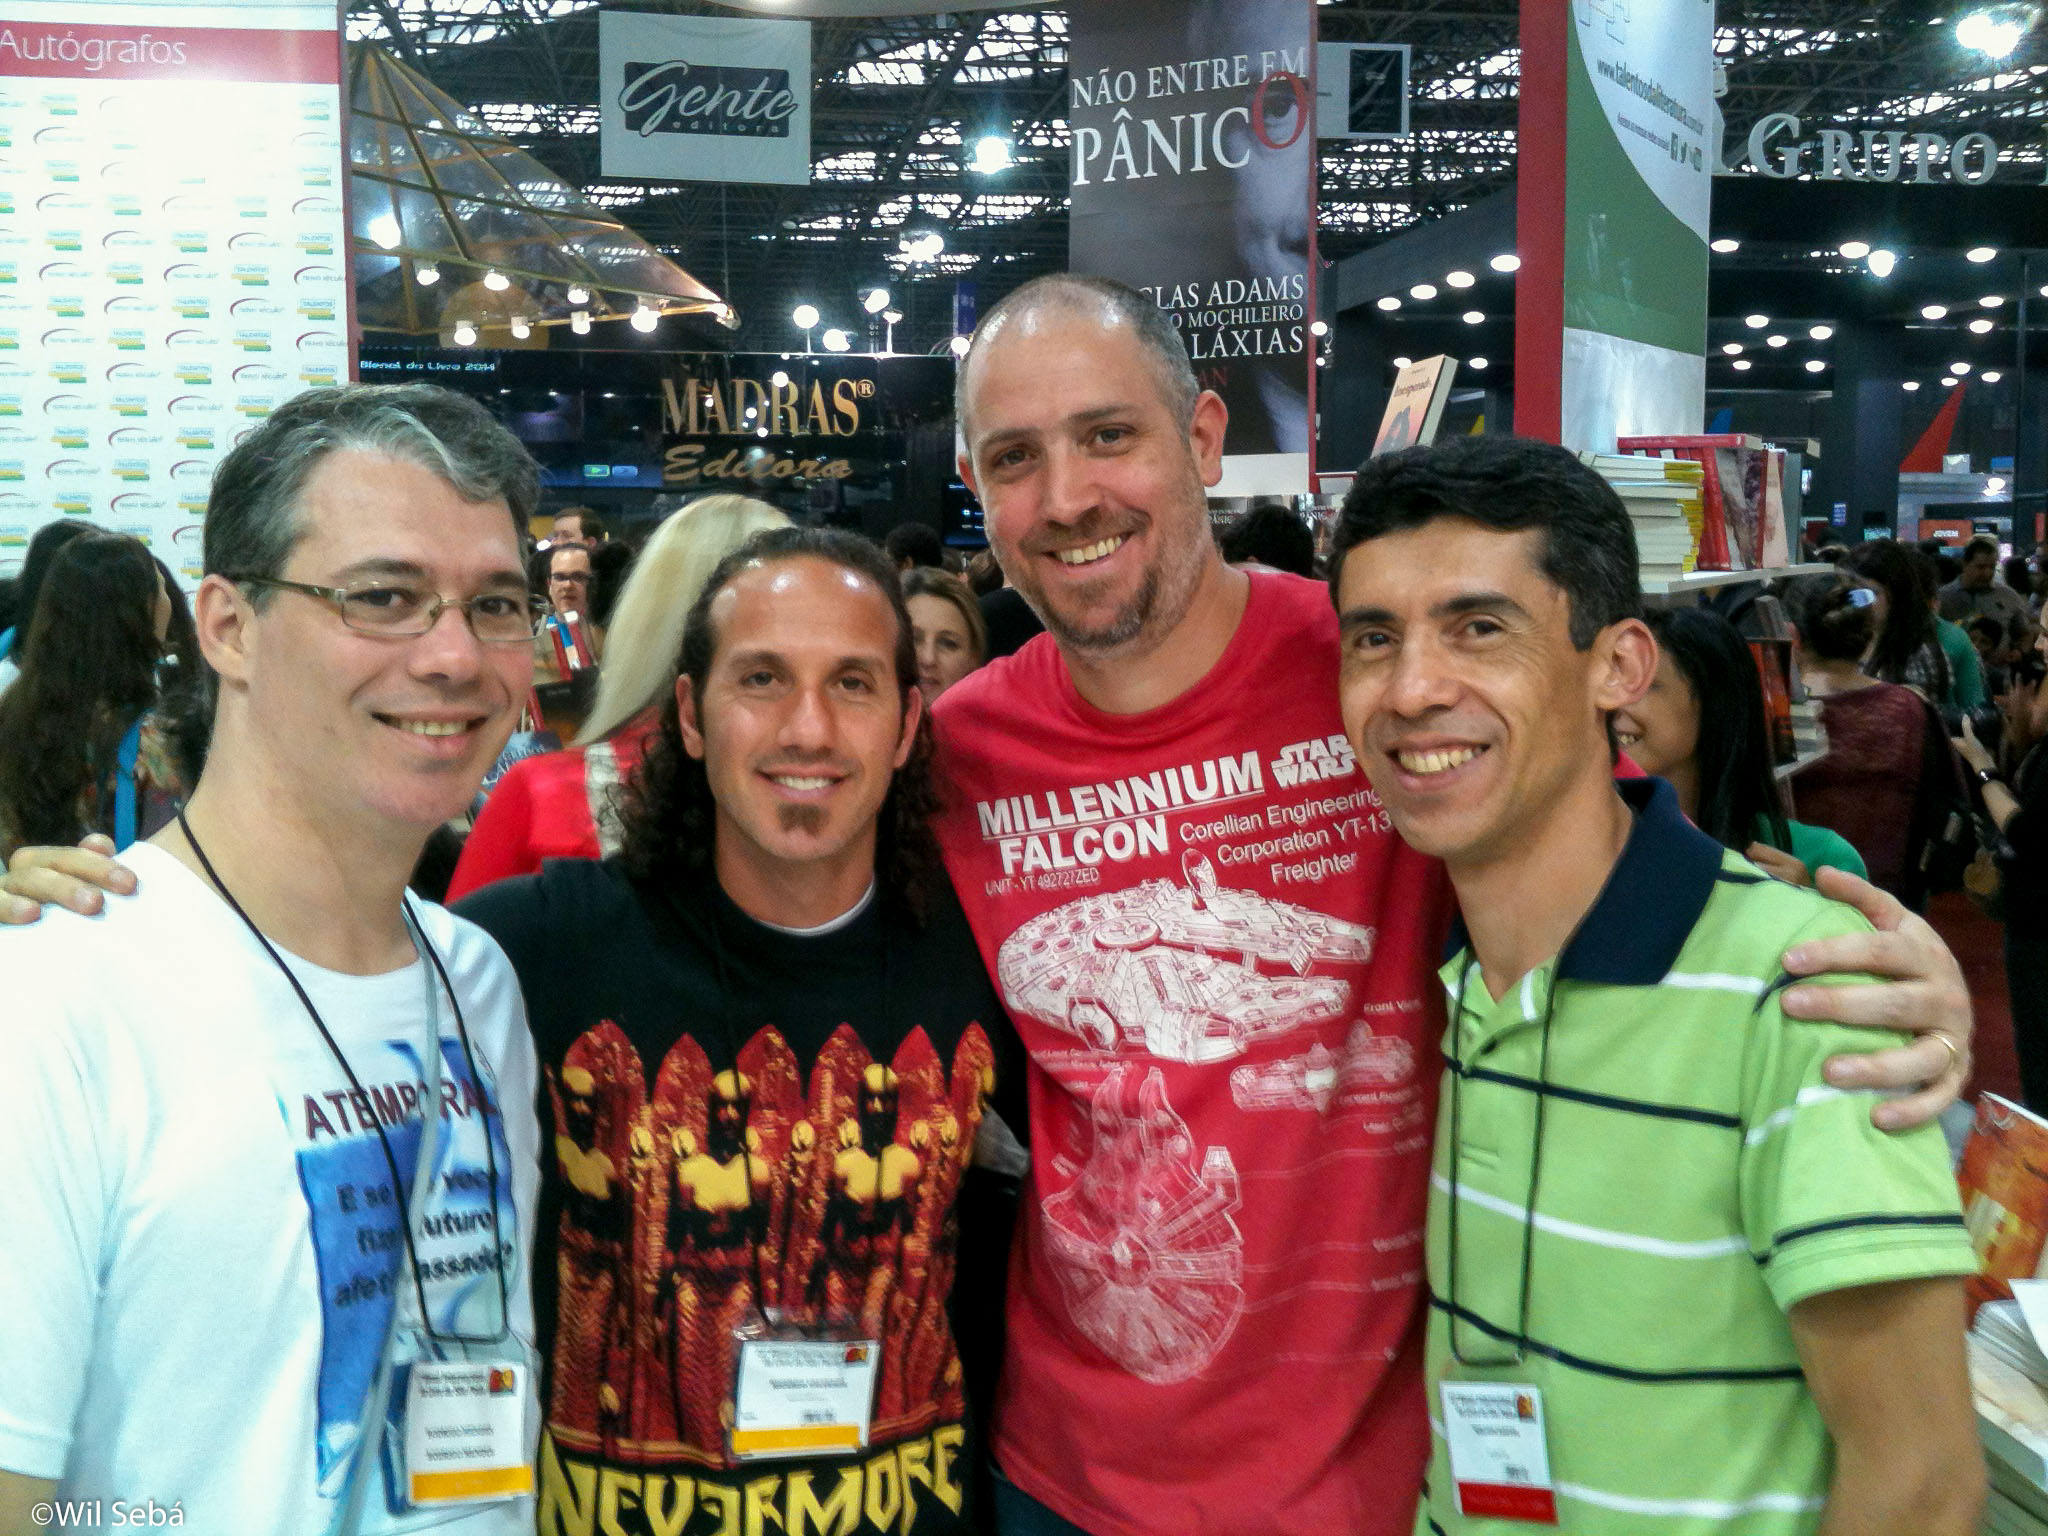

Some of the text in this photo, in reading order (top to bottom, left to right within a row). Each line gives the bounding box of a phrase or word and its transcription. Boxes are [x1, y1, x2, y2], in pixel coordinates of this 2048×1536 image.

[0, 29, 187, 71] Autógrafos
[1072, 47, 1307, 109] NÃO ENTRE EM
[618, 60, 799, 137] Gente
[672, 120, 779, 133] editora
[1072, 70, 1309, 186] PÂNICO
[1748, 112, 1999, 186] GRUPO
[1206, 274, 1304, 307] ADAMS
[1188, 304, 1304, 328] MOCHILEIRO
[663, 444, 853, 481] Editora
[1270, 734, 1354, 768] STAR
[1272, 751, 1357, 789] WARS
[976, 751, 1264, 838] MILLENNIUM
[1178, 788, 1383, 845] Corellian Engineering
[999, 815, 1171, 879] FALCON
[1216, 827, 1330, 867] Corporation
[985, 878, 1012, 896] UNIT
[1020, 875, 1036, 891] YT
[1269, 852, 1358, 886] Freighter
[420, 1208, 496, 1240] uturo
[537, 1423, 966, 1536] NEVERMORE
